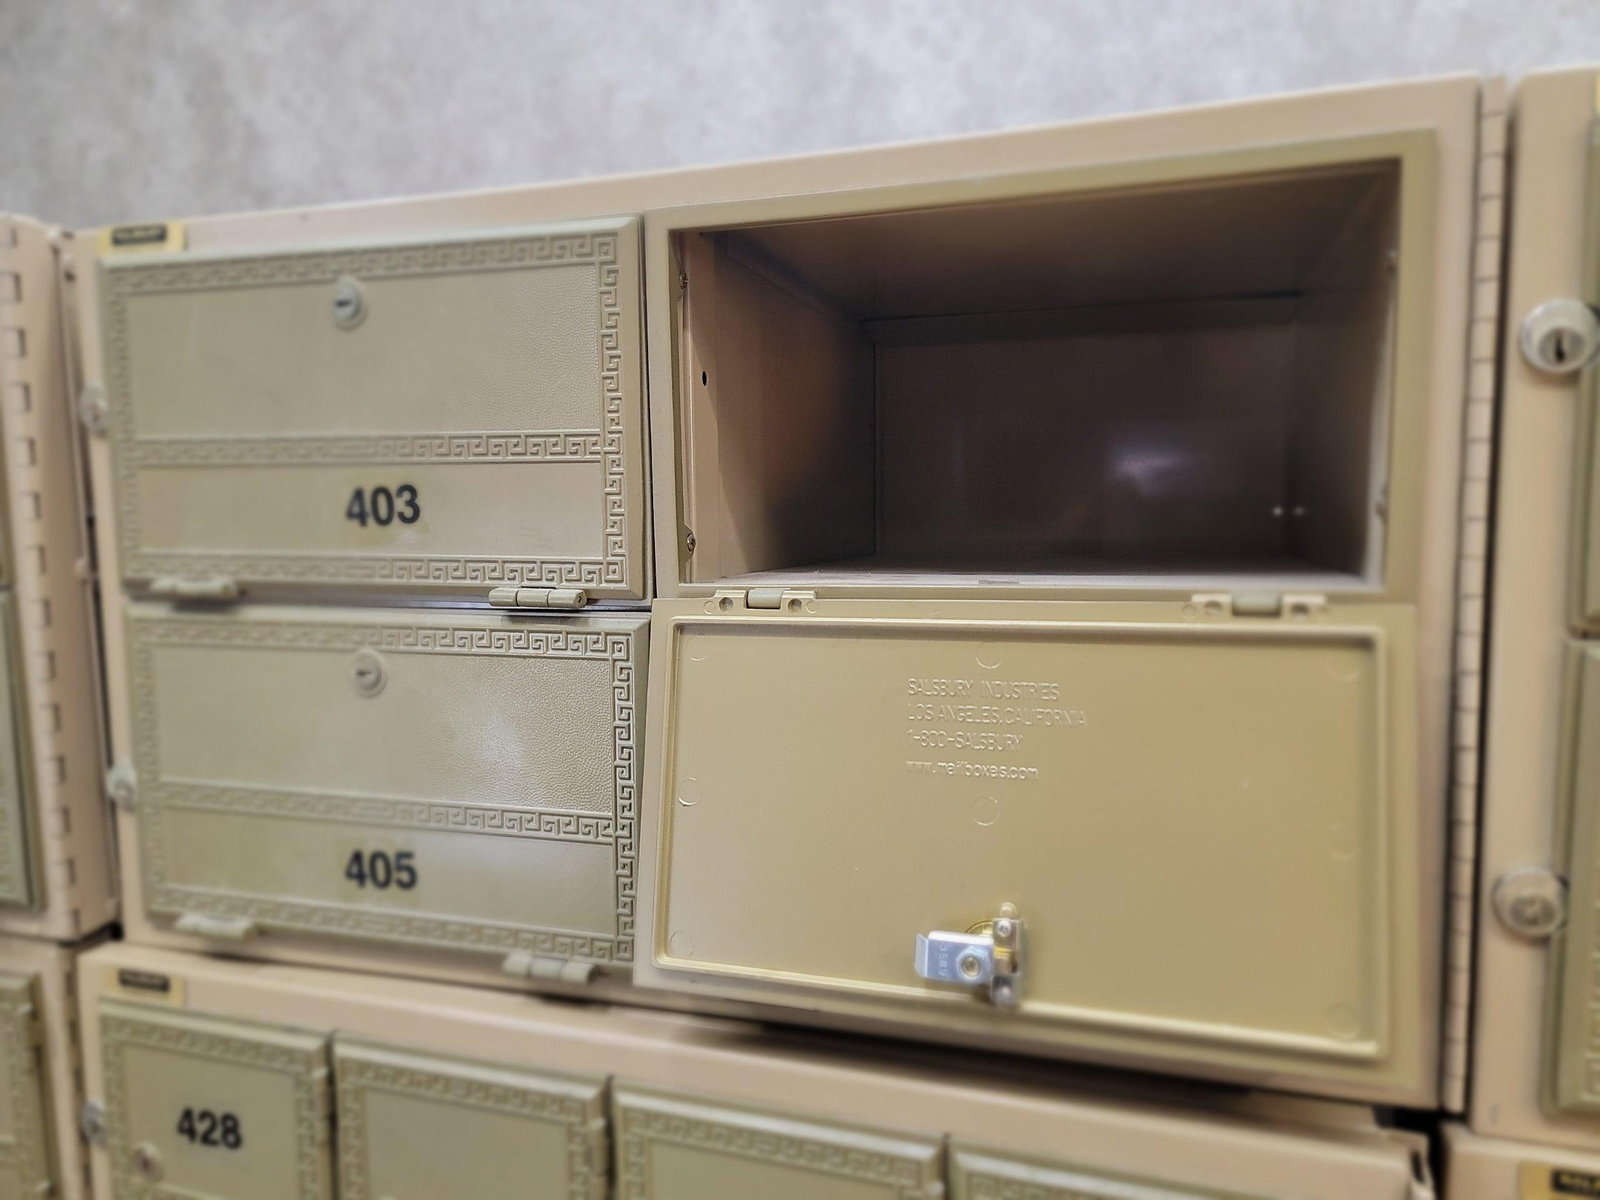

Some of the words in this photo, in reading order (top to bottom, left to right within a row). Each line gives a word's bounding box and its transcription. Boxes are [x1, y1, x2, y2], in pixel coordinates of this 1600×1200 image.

[345, 484, 421, 527] 403
[907, 678, 974, 698] SALSBURY
[980, 680, 1060, 701] INDUSTRIES
[907, 703, 934, 721] LOS
[906, 729, 1023, 751] 1-800-SALSBURY
[905, 760, 1039, 780] www.mailboxes.com
[344, 849, 418, 891] 405
[176, 1107, 242, 1150] 428
